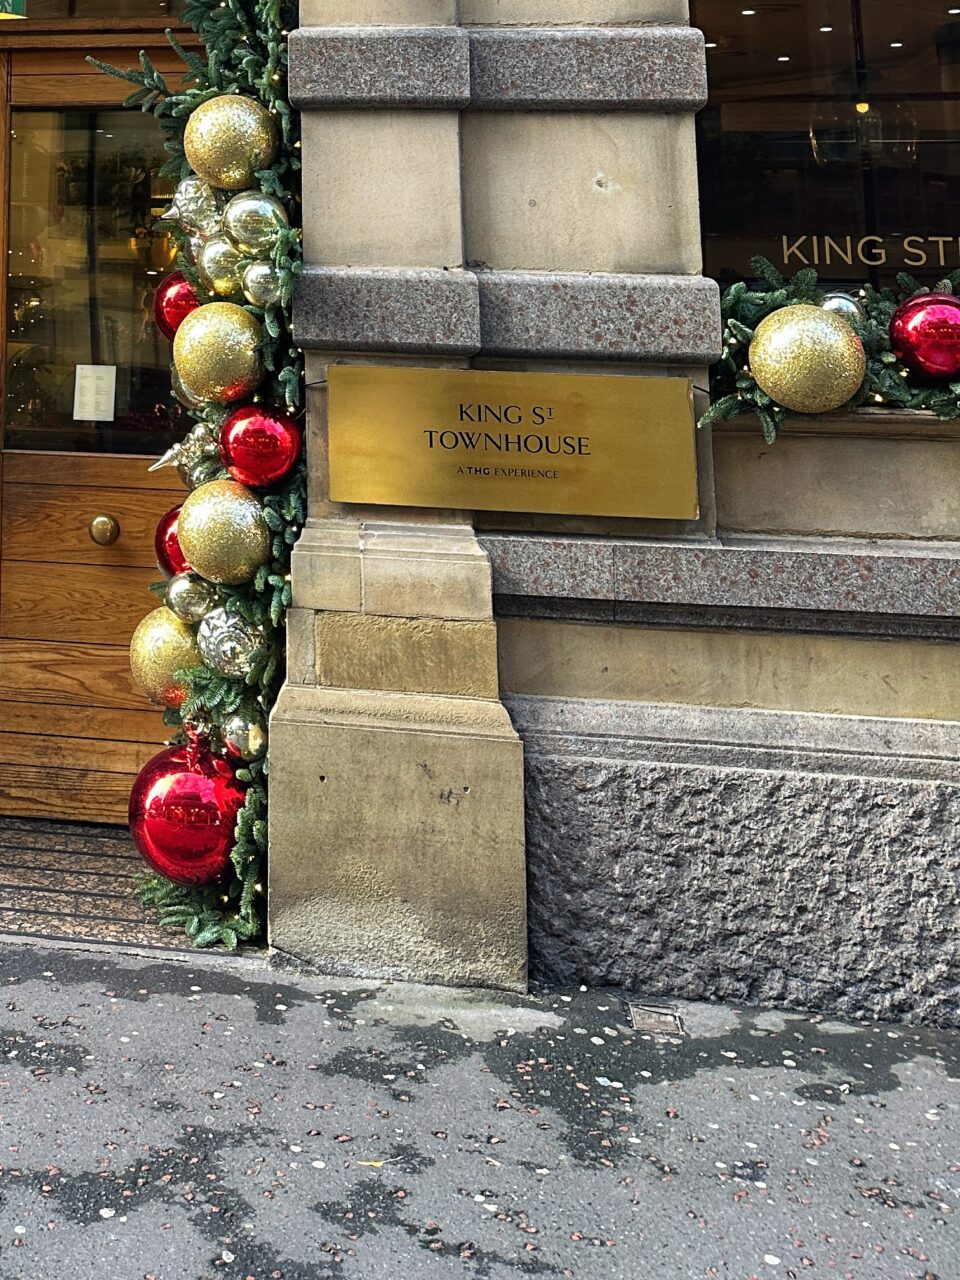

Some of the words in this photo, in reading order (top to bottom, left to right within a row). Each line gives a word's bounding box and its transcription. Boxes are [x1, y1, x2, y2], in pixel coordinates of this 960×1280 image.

[782, 234, 887, 266] KING
[903, 235, 960, 266] ST
[458, 403, 522, 424] KING
[423, 430, 592, 456] TOWNHOUSE
[456, 466, 464, 475] A
[467, 466, 491, 476] THG
[494, 467, 560, 479] EXPERIENCE
